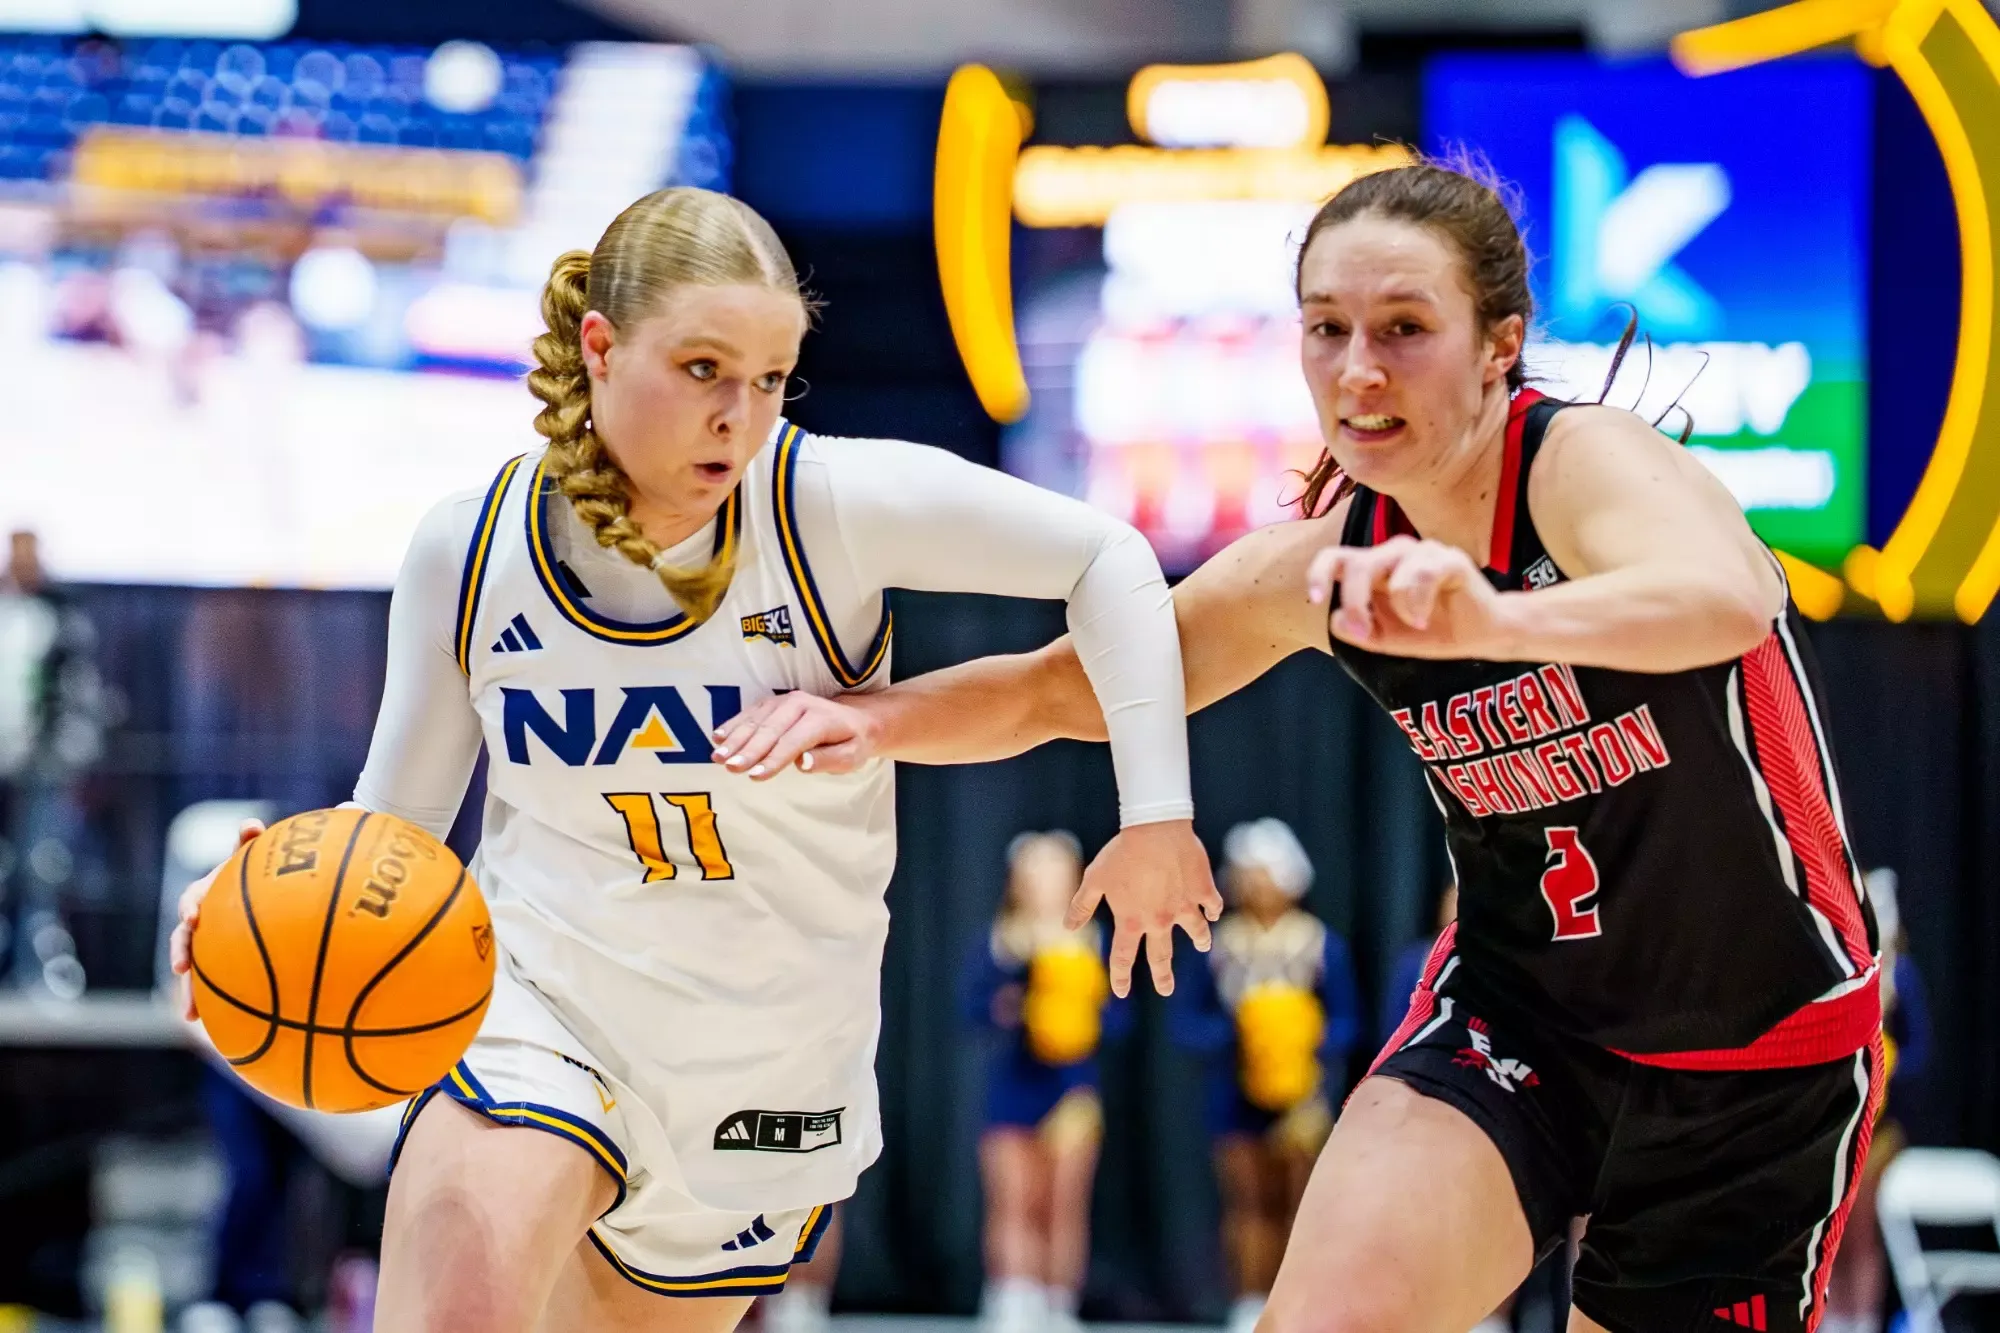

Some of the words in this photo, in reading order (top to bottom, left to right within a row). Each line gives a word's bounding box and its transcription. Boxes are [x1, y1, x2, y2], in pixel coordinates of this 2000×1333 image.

[742, 615, 766, 633] BIG
[764, 609, 791, 634] SKY
[1391, 663, 1591, 761] EASTERN
[1431, 704, 1671, 817] SHINGTON
[276, 810, 329, 877] CAA
[601, 791, 735, 885] 11
[1540, 826, 1602, 942] 2
[774, 1127, 786, 1142] M
